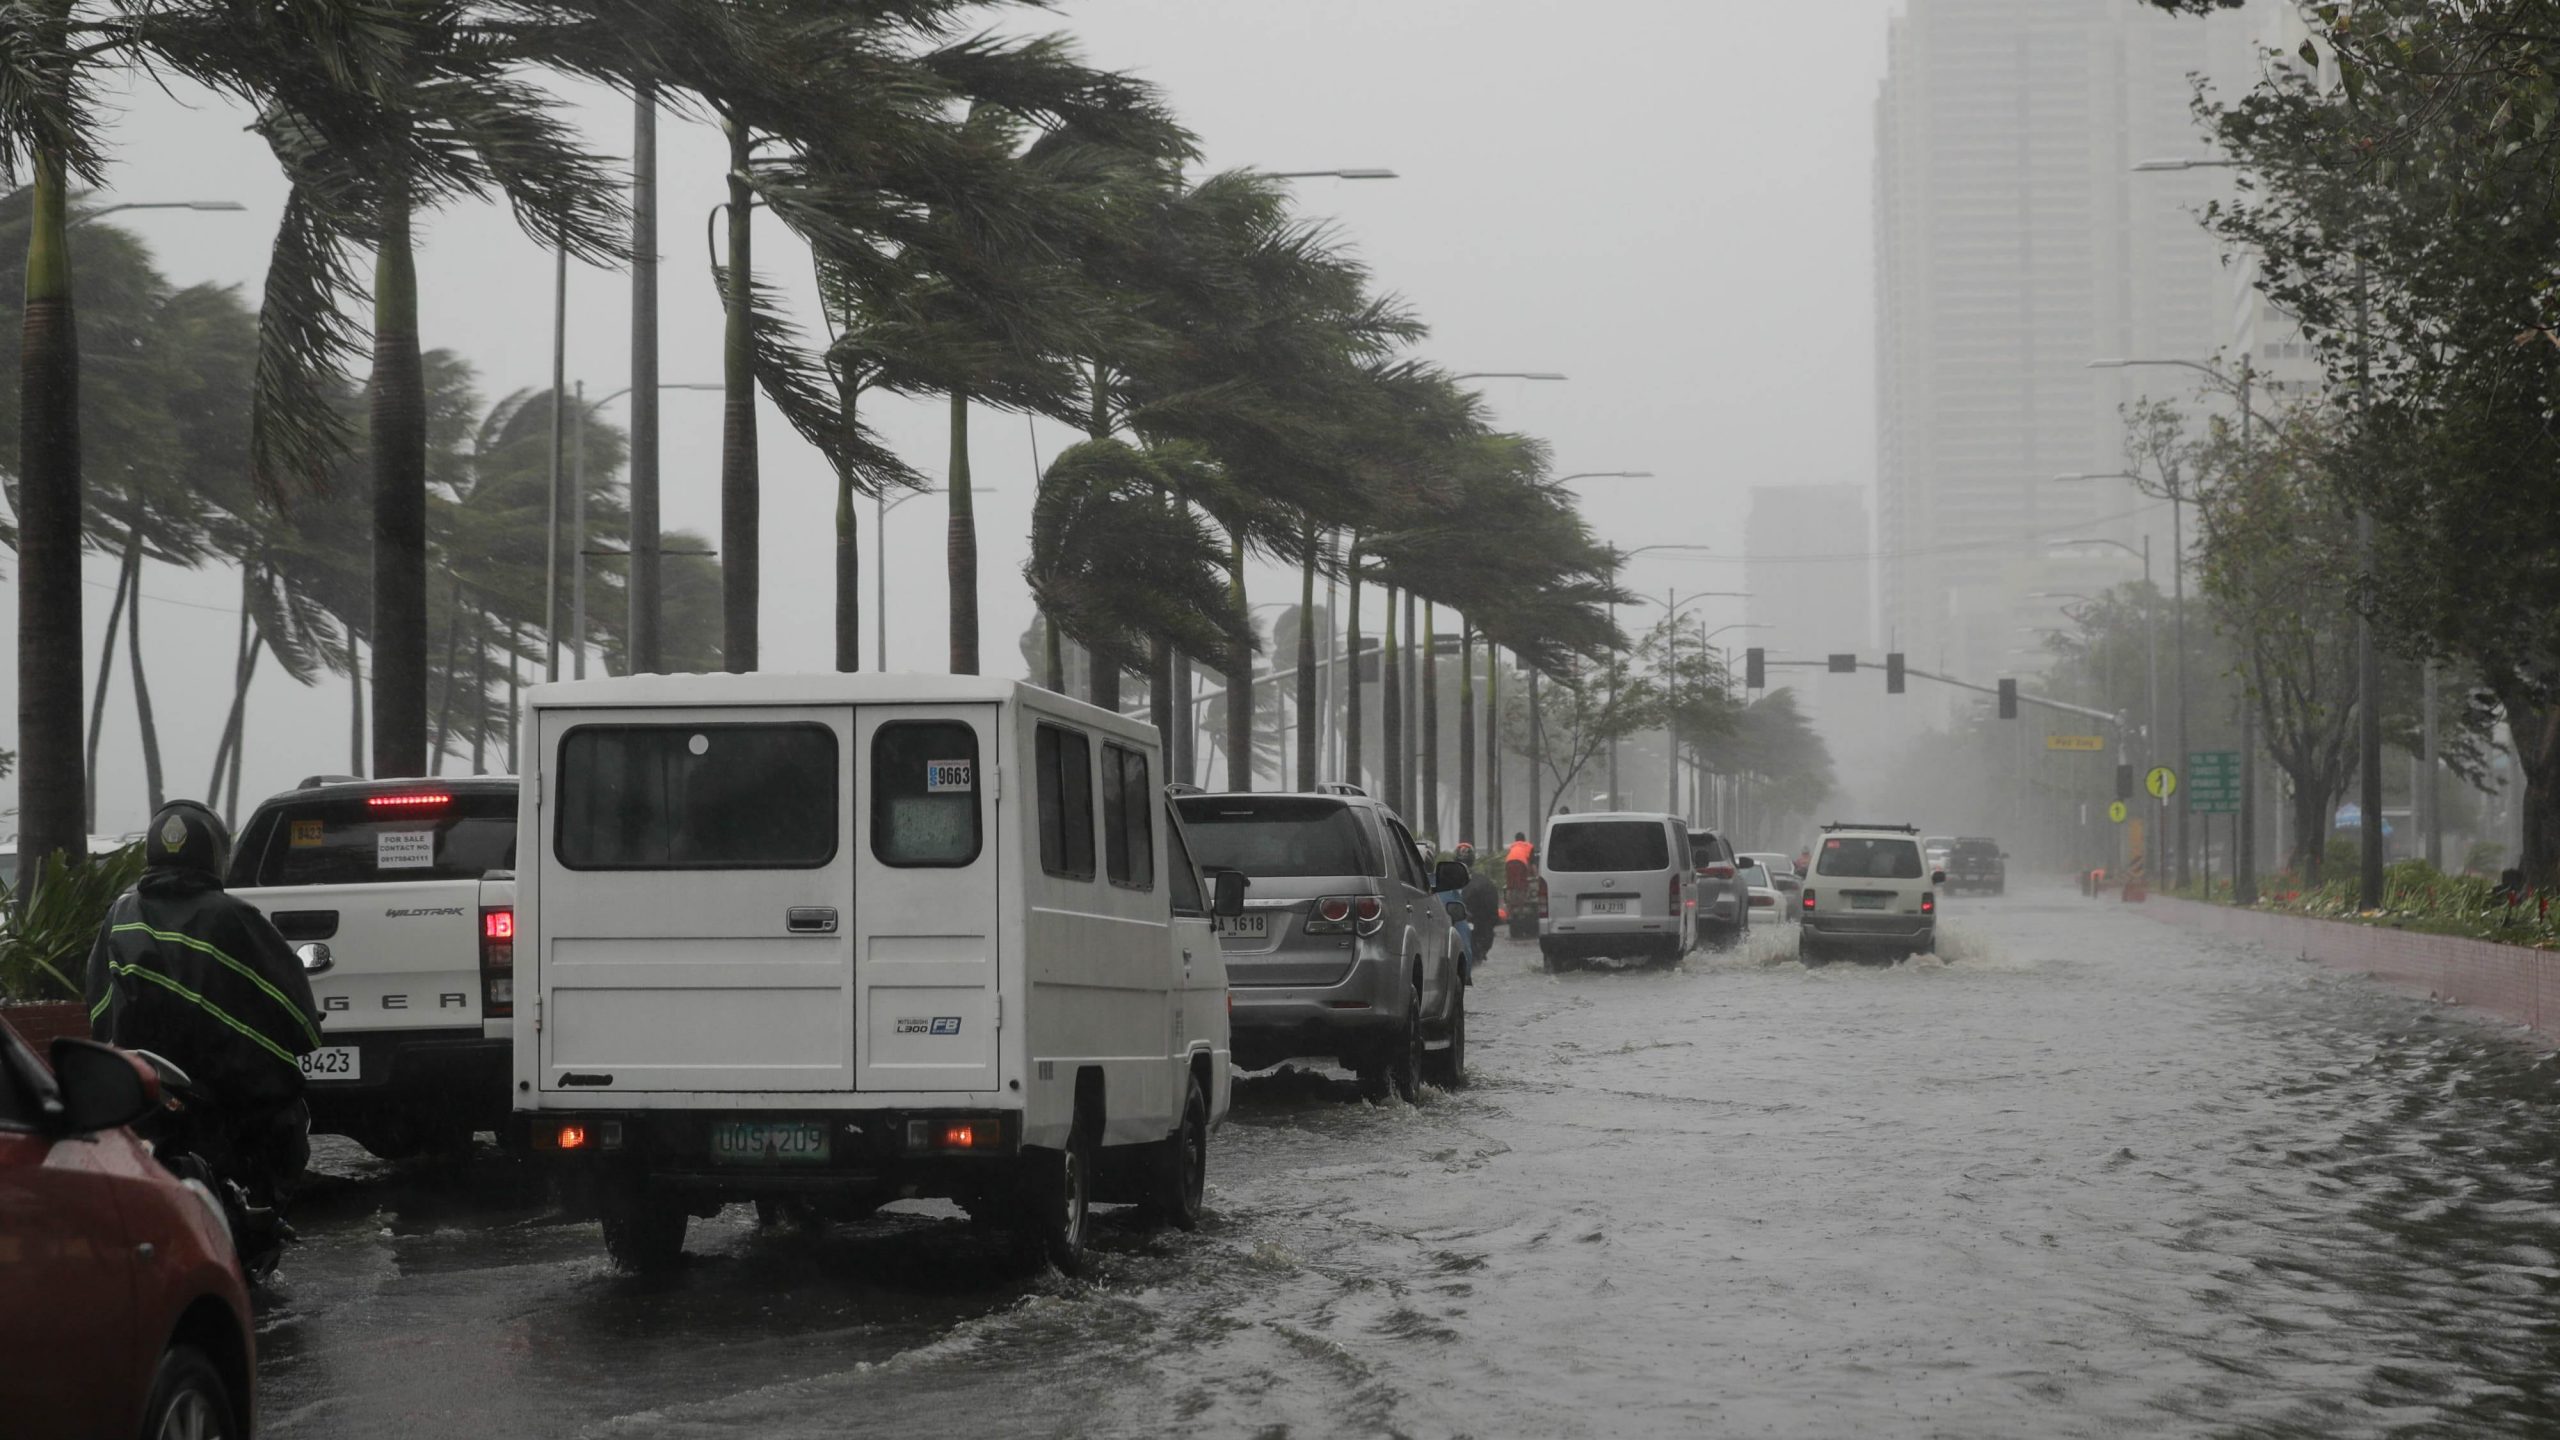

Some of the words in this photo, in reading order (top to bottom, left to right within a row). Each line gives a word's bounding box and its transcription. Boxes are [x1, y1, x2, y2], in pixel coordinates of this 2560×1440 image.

[938, 766, 970, 785] 9663
[297, 826, 322, 840] 8423
[403, 835, 425, 843] SALE
[379, 844, 415, 852] CONTACT
[385, 907, 465, 919] WILDTRAK
[1232, 916, 1264, 931] 1618
[323, 992, 468, 1012] GER
[896, 1025, 928, 1033] L300
[932, 1018, 959, 1030] FB
[301, 1053, 350, 1073] 8423
[777, 1127, 822, 1152] 209
